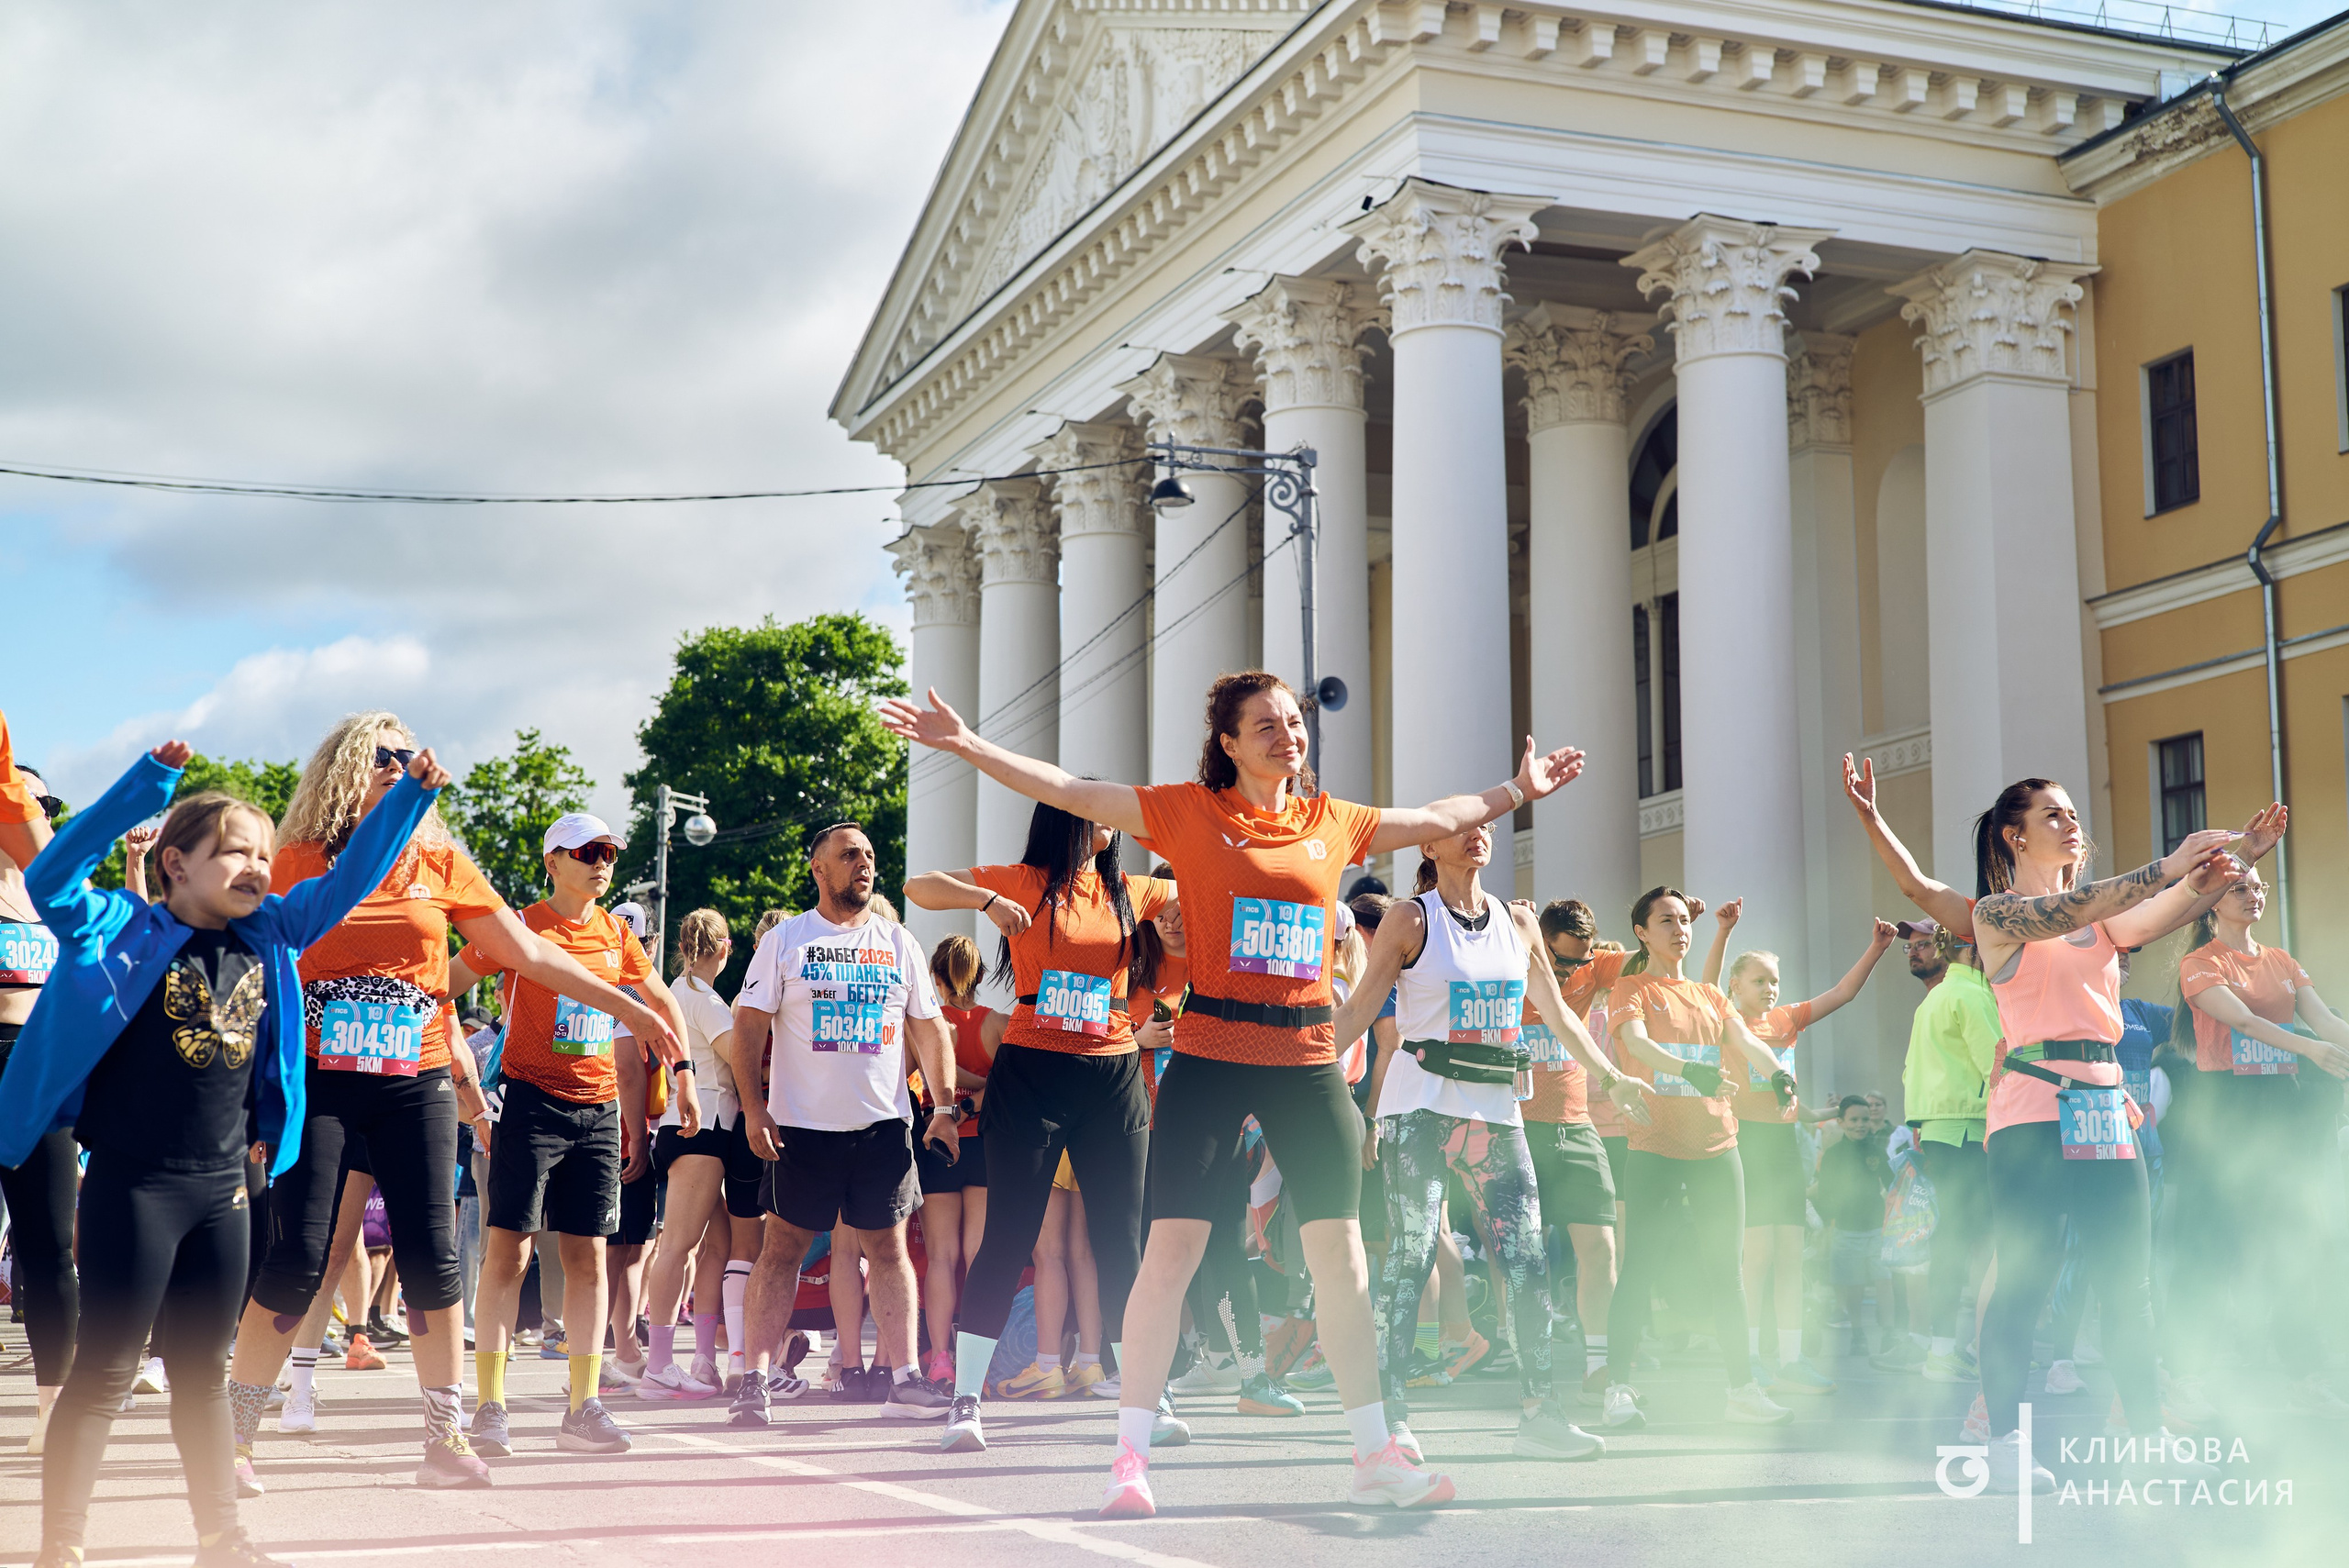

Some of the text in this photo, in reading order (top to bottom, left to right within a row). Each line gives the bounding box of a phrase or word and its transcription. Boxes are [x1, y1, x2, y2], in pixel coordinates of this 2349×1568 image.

[1242, 919, 1316, 963] 50380
[807, 946, 895, 967] #ЗАБЕГ2025
[800, 963, 902, 984] 45% ПЛАНЕТЫ
[1266, 959, 1295, 978] 10KM
[847, 984, 890, 1004] БЕГУТ
[1043, 986, 1104, 1021] 30095
[1461, 997, 1517, 1029] 30195
[566, 1013, 611, 1042] 10066
[819, 1015, 876, 1042] 50348
[882, 1022, 896, 1045] ОЙ
[1062, 1017, 1084, 1033] 5KM
[330, 1020, 412, 1059] 30430
[1481, 1029, 1501, 1043] 5KM
[584, 1042, 599, 1056] 1KM
[837, 1041, 859, 1053] 10KM
[356, 1055, 384, 1073] 5KM
[1546, 1061, 1564, 1072] 5KM
[2261, 1063, 2278, 1074] 5KM
[2096, 1144, 2117, 1160] 5KM
